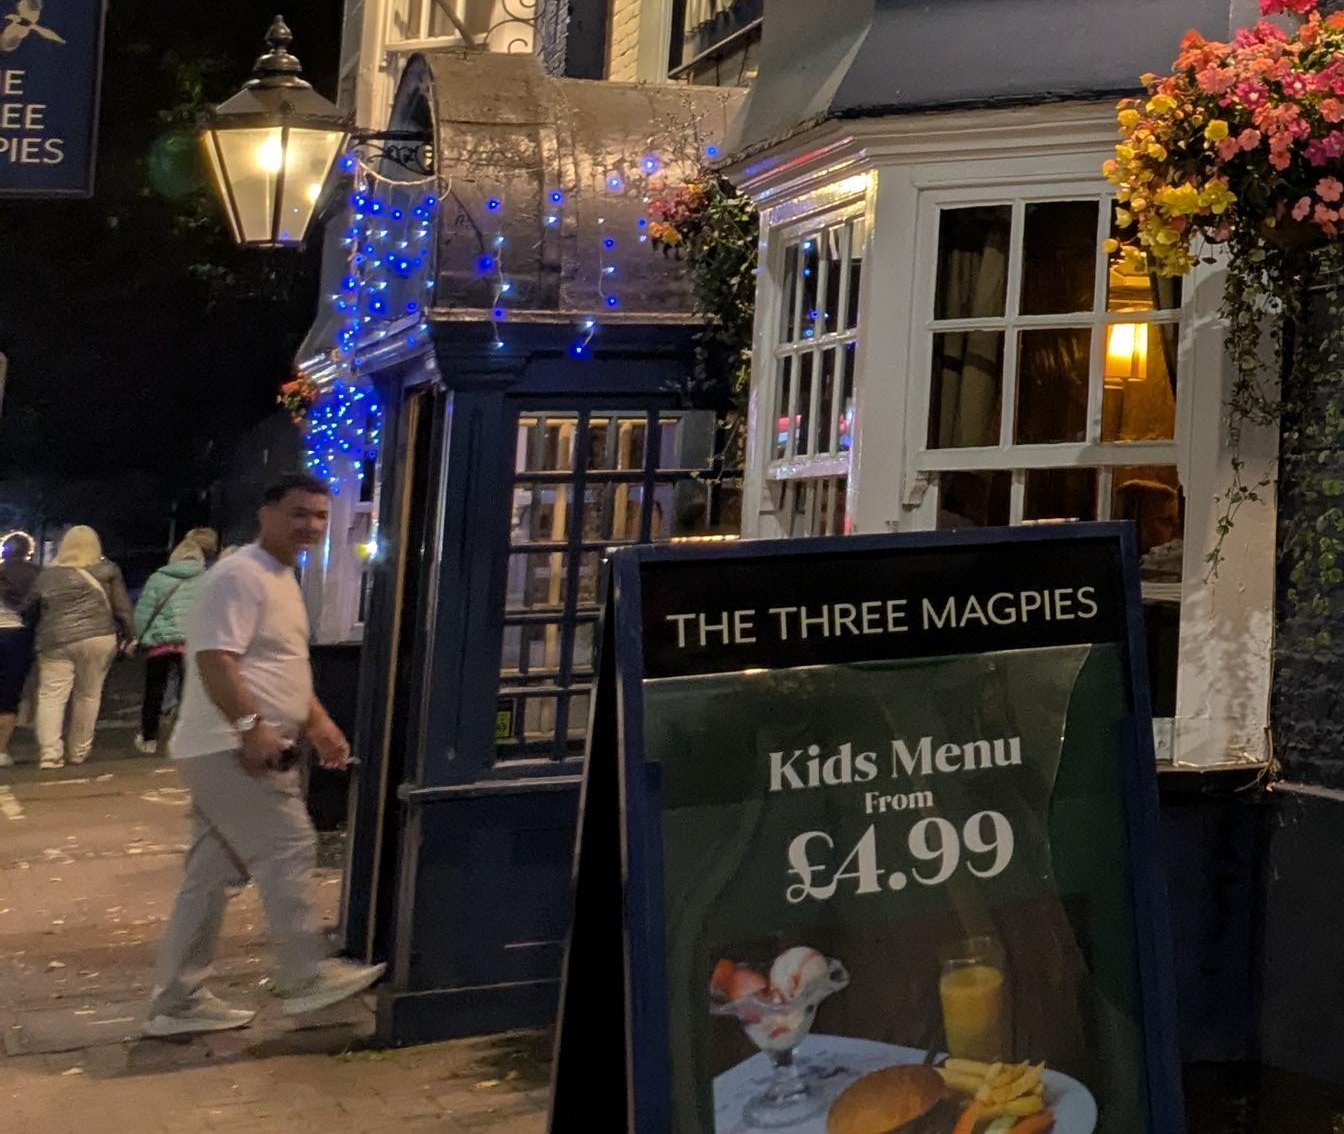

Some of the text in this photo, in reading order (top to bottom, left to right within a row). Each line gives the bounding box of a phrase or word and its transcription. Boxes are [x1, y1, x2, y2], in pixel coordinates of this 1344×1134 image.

[666, 586, 1099, 649] THE THREE MAGPIES
[768, 735, 1023, 793] Kids Menu
[864, 788, 934, 815] From
[785, 810, 1015, 904] £4.99
